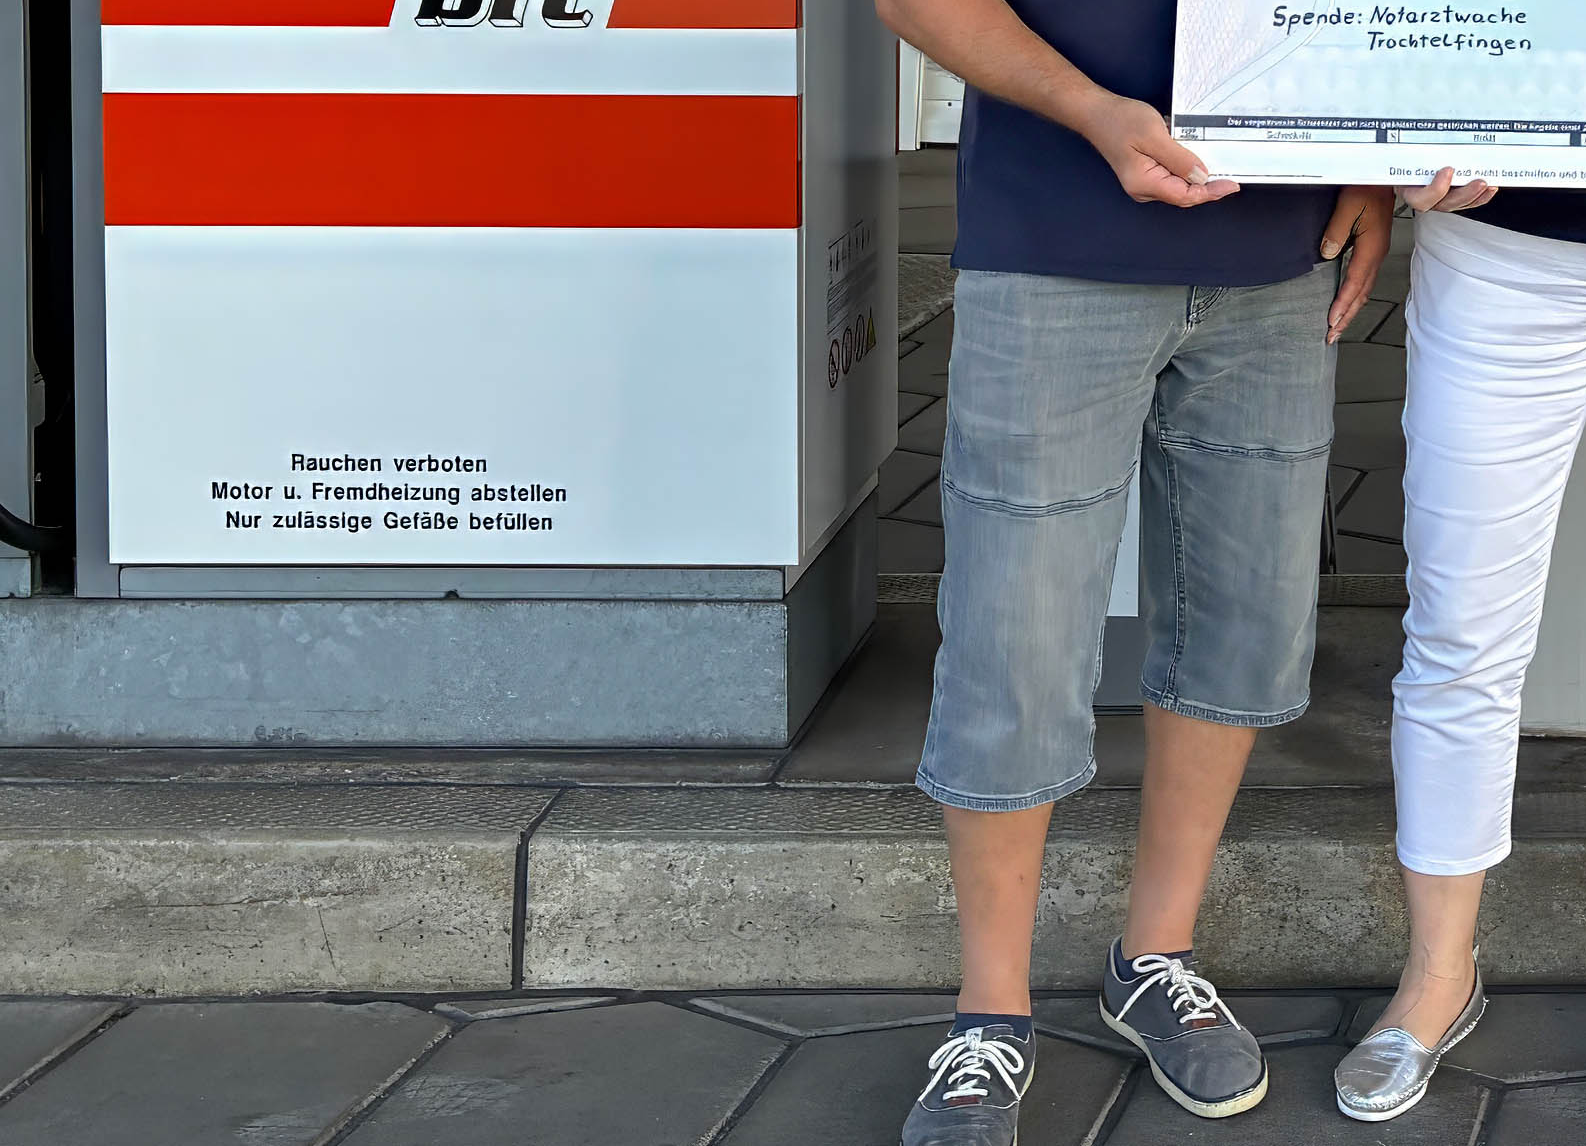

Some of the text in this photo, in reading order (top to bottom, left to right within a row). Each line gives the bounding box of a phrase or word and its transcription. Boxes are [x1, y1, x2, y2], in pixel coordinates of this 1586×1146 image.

[1272, 5, 1527, 35] Spende: Notarztwache
[1367, 31, 1532, 56] Trochtelfingen
[291, 453, 487, 472] Rauchen verboten
[212, 482, 567, 505] Motor u. Fremdheizung abstellen
[226, 510, 552, 533] Nur zulässige Gefäße befüllen
